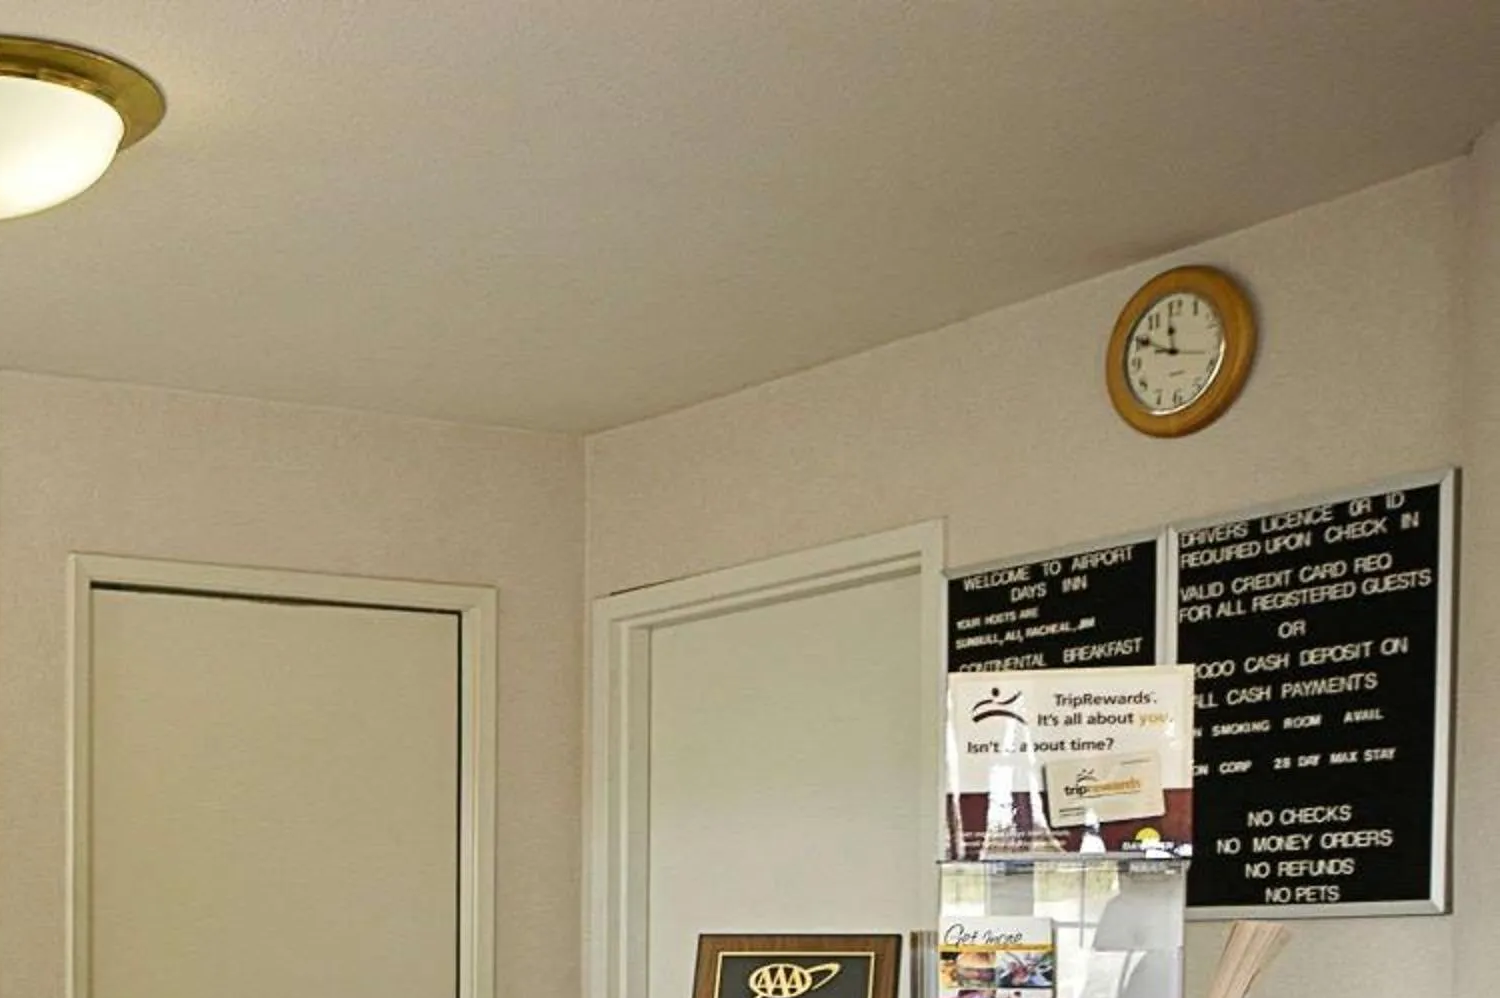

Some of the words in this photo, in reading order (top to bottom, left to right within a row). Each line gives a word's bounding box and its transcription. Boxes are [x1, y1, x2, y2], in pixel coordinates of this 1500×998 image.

[1181, 521, 1249, 548] DRIVERS
[1261, 504, 1335, 533] LICENCE
[1348, 497, 1372, 517] OR
[1386, 492, 1405, 509] ID
[1265, 531, 1311, 555] UPON
[1324, 516, 1388, 543] CHECK
[1401, 511, 1420, 529] IN
[963, 566, 1030, 592] WELCOME
[1042, 560, 1062, 577] TO
[1071, 545, 1136, 571] AIRPORT
[1180, 581, 1225, 602] VALID
[1231, 569, 1293, 595] CREDIT
[1299, 560, 1348, 583] CARD
[1011, 582, 1047, 603] DAYS
[1062, 574, 1088, 594] INN
[1179, 603, 1212, 624] FOR
[1216, 599, 1247, 618] ALL
[1252, 581, 1357, 613] REGISTERED
[1362, 568, 1432, 595] GUESTS
[955, 616, 980, 630] YOUR
[985, 610, 1016, 625] HOSTS
[1019, 607, 1038, 619] ARE
[1278, 619, 1307, 639] OR
[1063, 637, 1144, 663] BREAKFAST
[1194, 659, 1235, 679] 000
[1243, 652, 1290, 674] CASH
[1299, 640, 1375, 667] DEPOSIT
[1380, 636, 1409, 656] ON
[1226, 685, 1271, 705] CASH
[1281, 672, 1379, 699] PAYMENTS
[1037, 713, 1059, 726] It's
[1063, 712, 1082, 726] all
[1086, 711, 1134, 726] about
[1211, 719, 1271, 738] SMOKING
[1282, 713, 1323, 730] ROOM
[1343, 707, 1385, 725] AVAIL
[967, 740, 1000, 754] Isn't
[1070, 737, 1115, 753] time?
[1219, 759, 1253, 775] CORP
[1297, 754, 1321, 768] DAY
[1329, 750, 1359, 765] MAX
[1363, 746, 1397, 762] STAY
[1247, 809, 1274, 827] NO
[1279, 804, 1352, 825] CHECKS
[1216, 837, 1241, 855] NO
[1252, 833, 1313, 853] MONEY
[1320, 829, 1394, 850] ORDERS
[1244, 861, 1271, 879] NO
[1277, 857, 1355, 878] REFUNDS
[1265, 887, 1291, 903] NO
[1295, 885, 1341, 902] PETS
[756, 964, 805, 998] AAA
